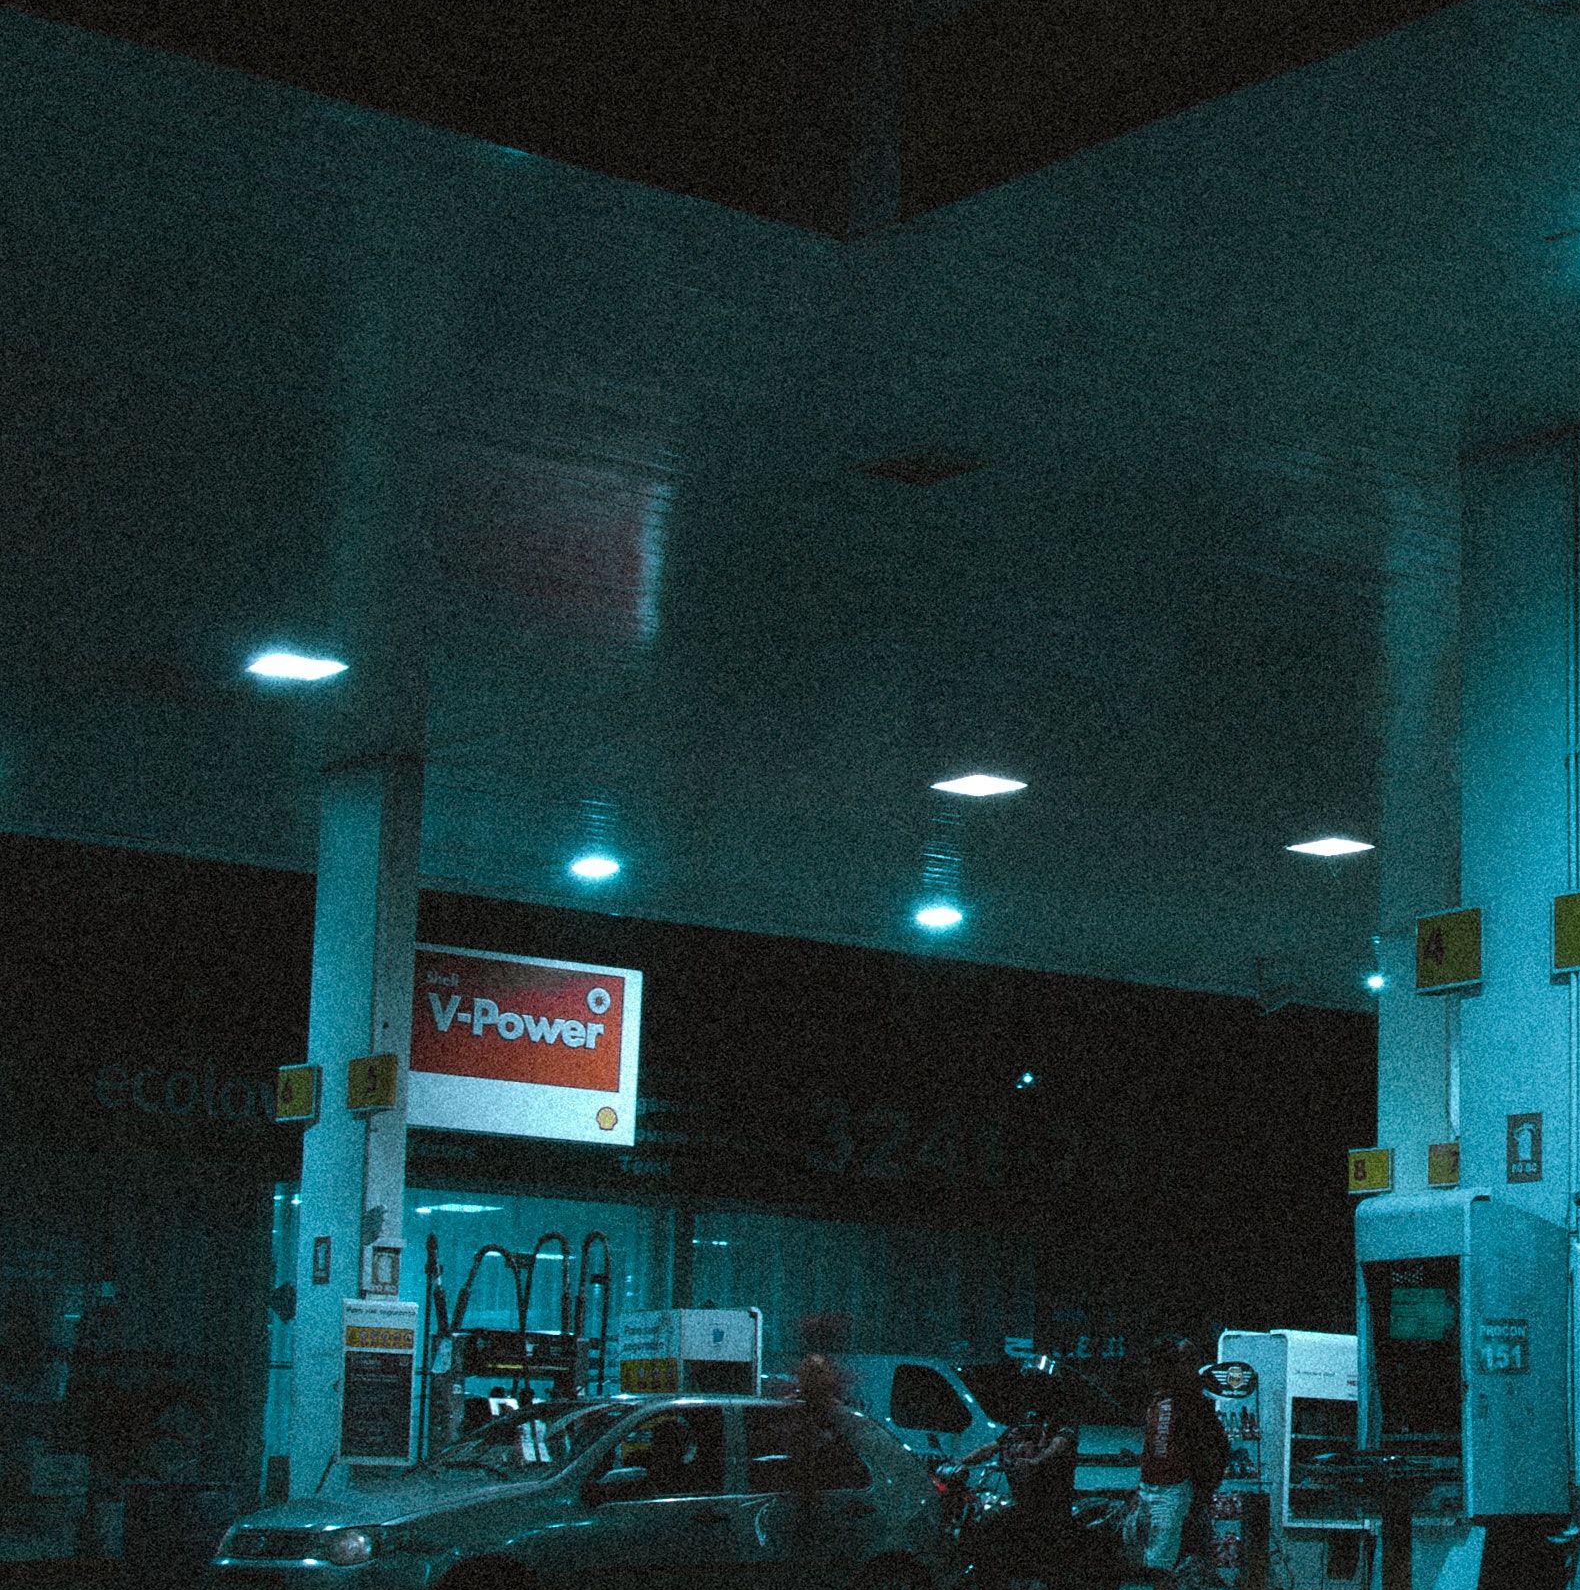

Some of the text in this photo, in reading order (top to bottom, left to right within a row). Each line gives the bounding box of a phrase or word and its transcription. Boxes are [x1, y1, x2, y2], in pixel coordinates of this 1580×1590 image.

[1423, 925, 1445, 966] 4
[427, 992, 606, 1050] V-Power
[282, 1076, 294, 1104] 6
[1353, 1158, 1367, 1181] 8
[1481, 1344, 1523, 1371] 151
